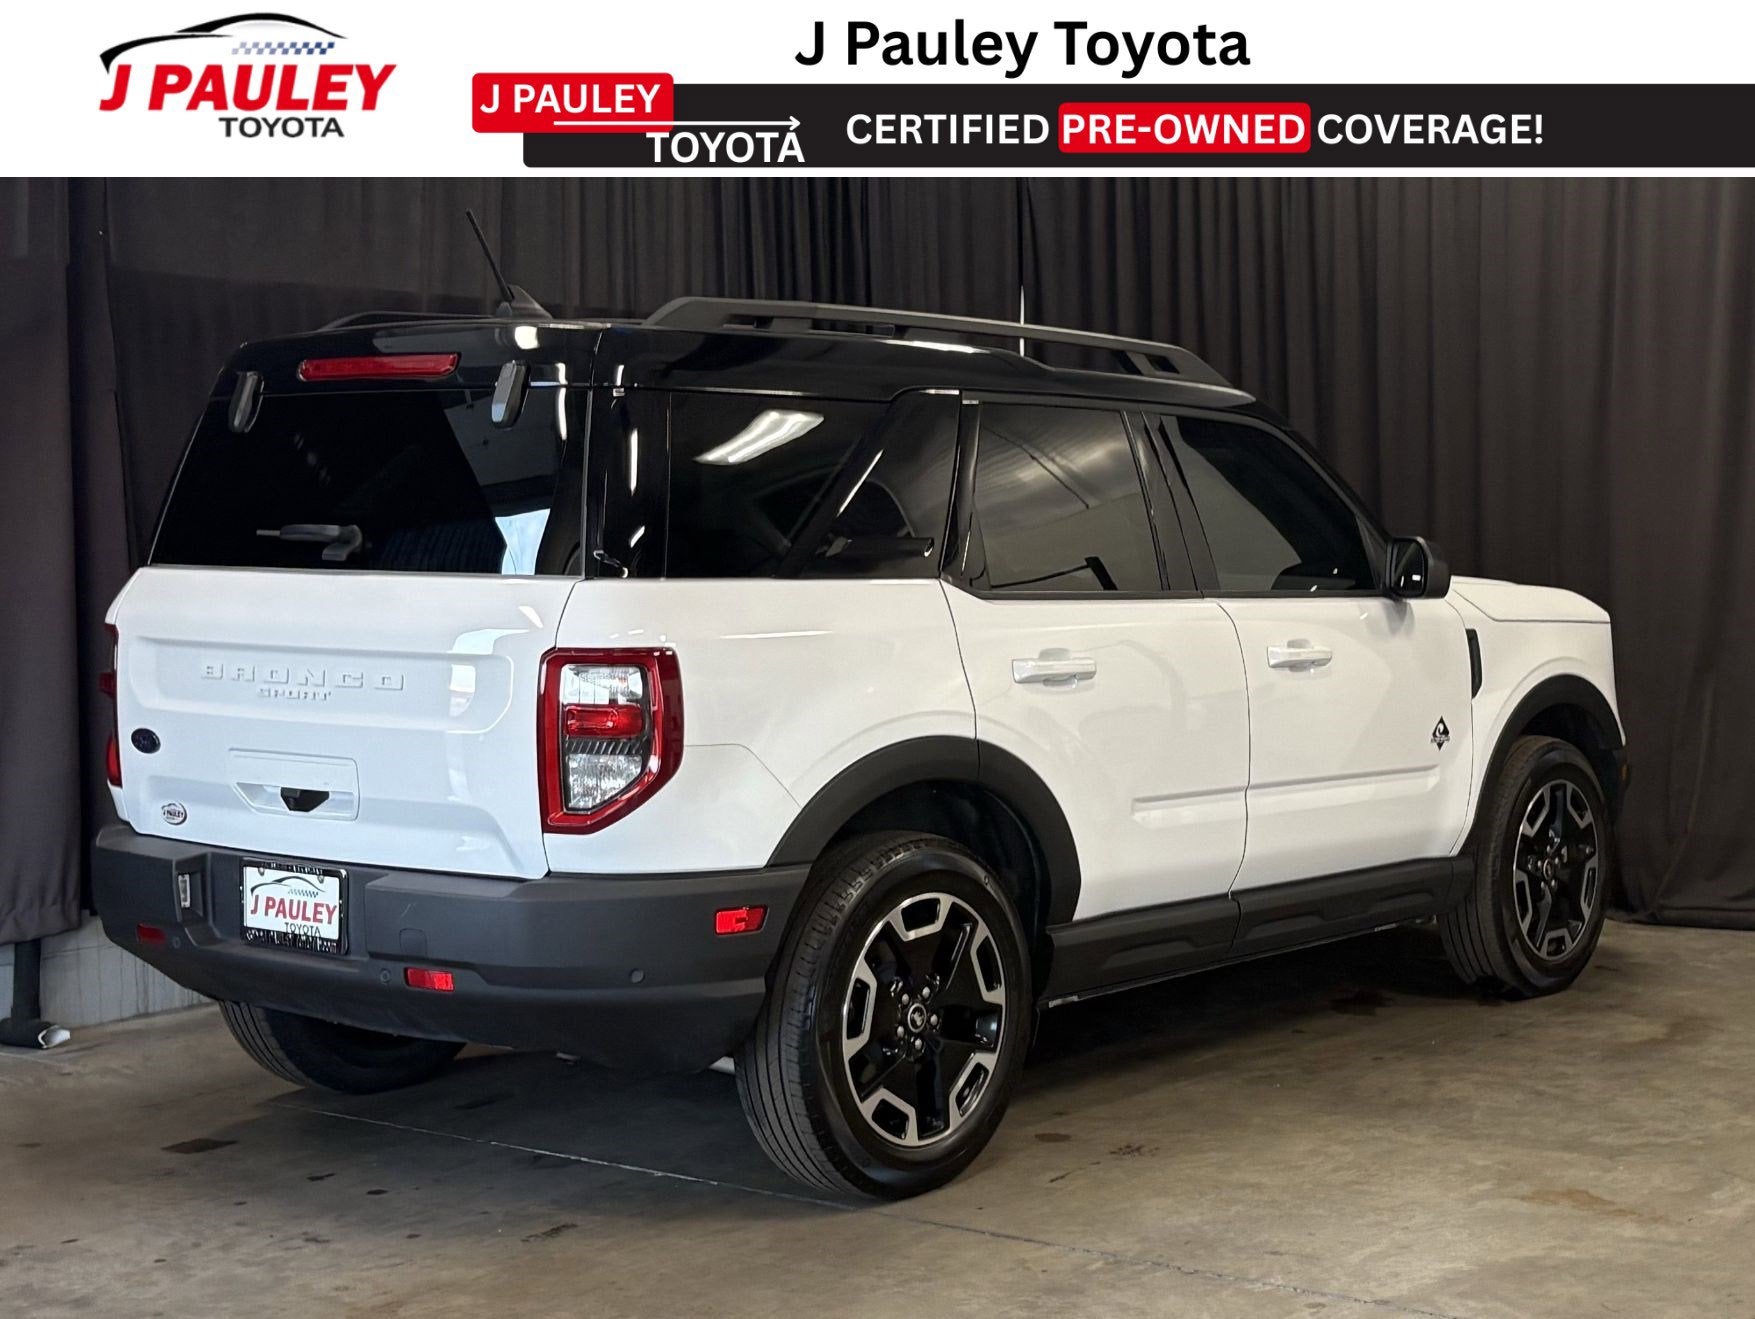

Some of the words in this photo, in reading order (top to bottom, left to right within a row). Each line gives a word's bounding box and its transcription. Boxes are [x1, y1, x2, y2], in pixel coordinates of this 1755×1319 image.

[200, 662, 405, 691] BRONCO
[258, 686, 332, 701] SPORT
[250, 894, 260, 915] J
[264, 895, 338, 925] PAULEY
[284, 922, 321, 937] TOYOTA
